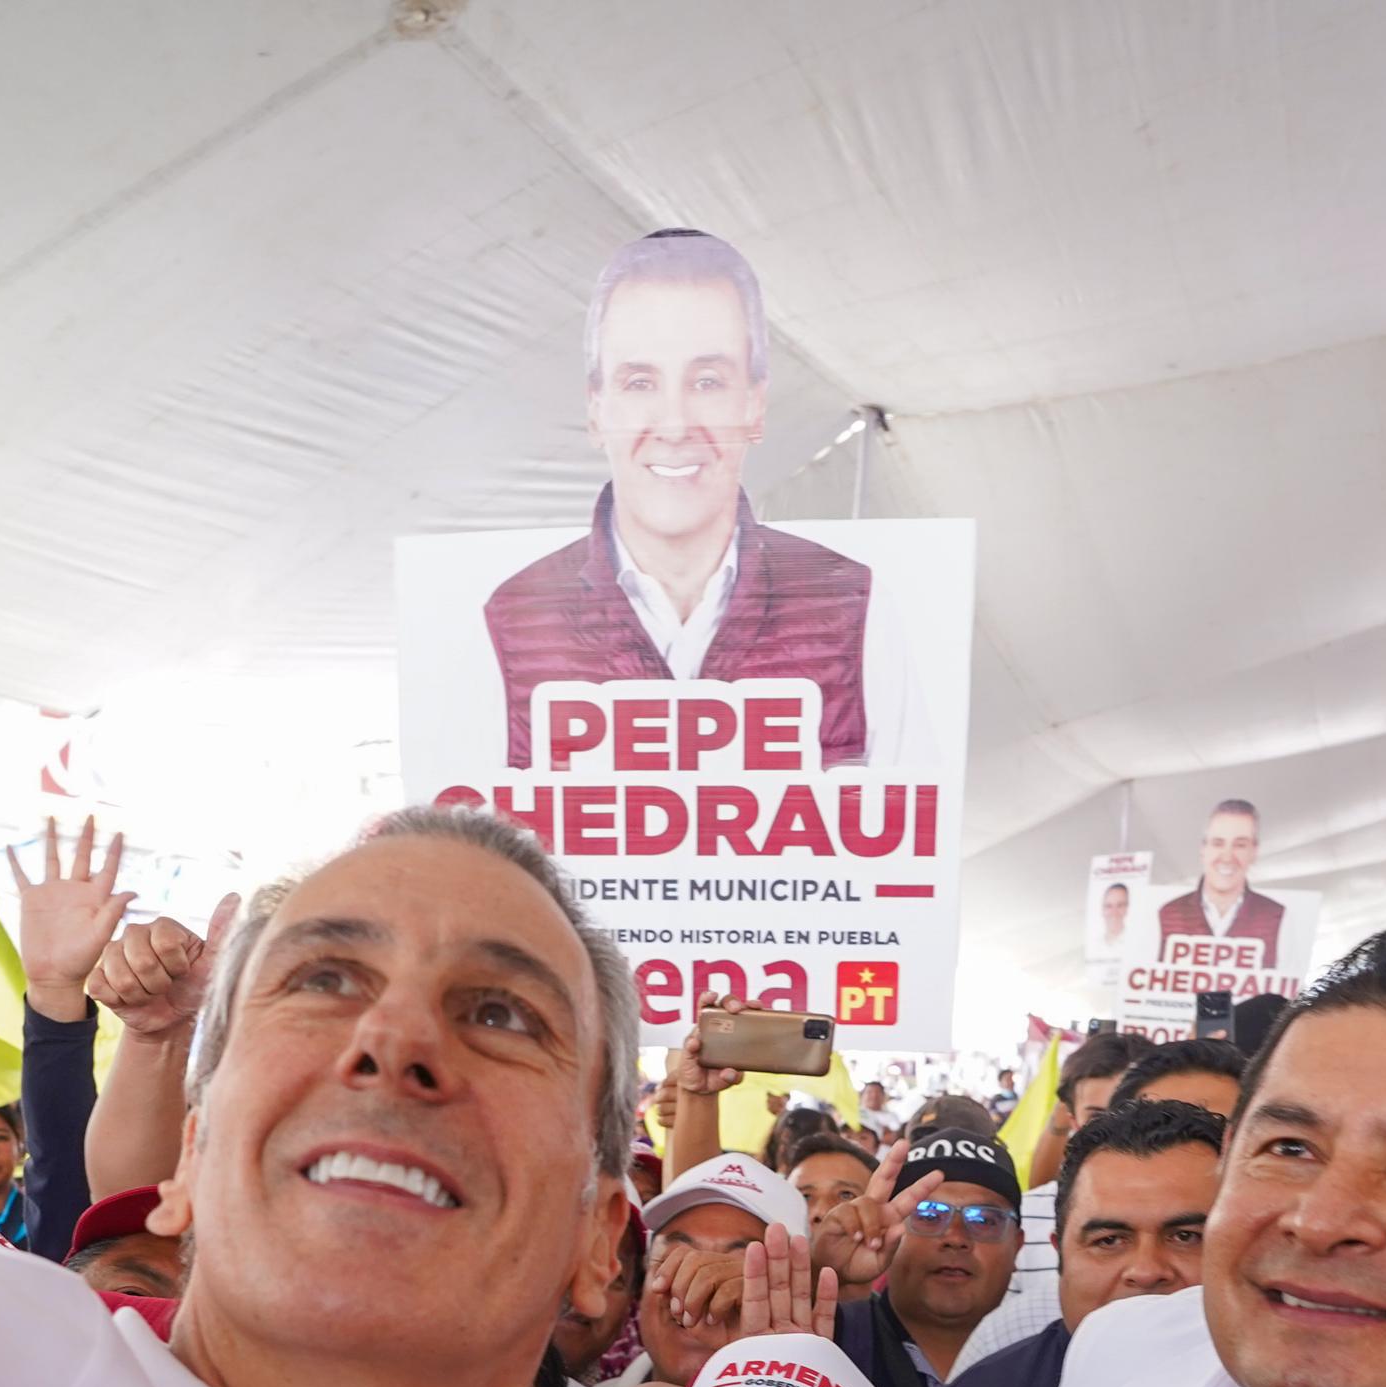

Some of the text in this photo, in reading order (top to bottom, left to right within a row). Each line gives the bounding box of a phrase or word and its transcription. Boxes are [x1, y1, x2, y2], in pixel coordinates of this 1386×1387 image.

[548, 697, 803, 772] PEPE
[688, 878, 862, 902] MUNICIPAL
[680, 929, 777, 945] HISTORIA
[784, 930, 810, 945] EN
[817, 930, 901, 946] PUEBLA
[1172, 942, 1256, 968] PEPE
[838, 986, 894, 1021] PT
